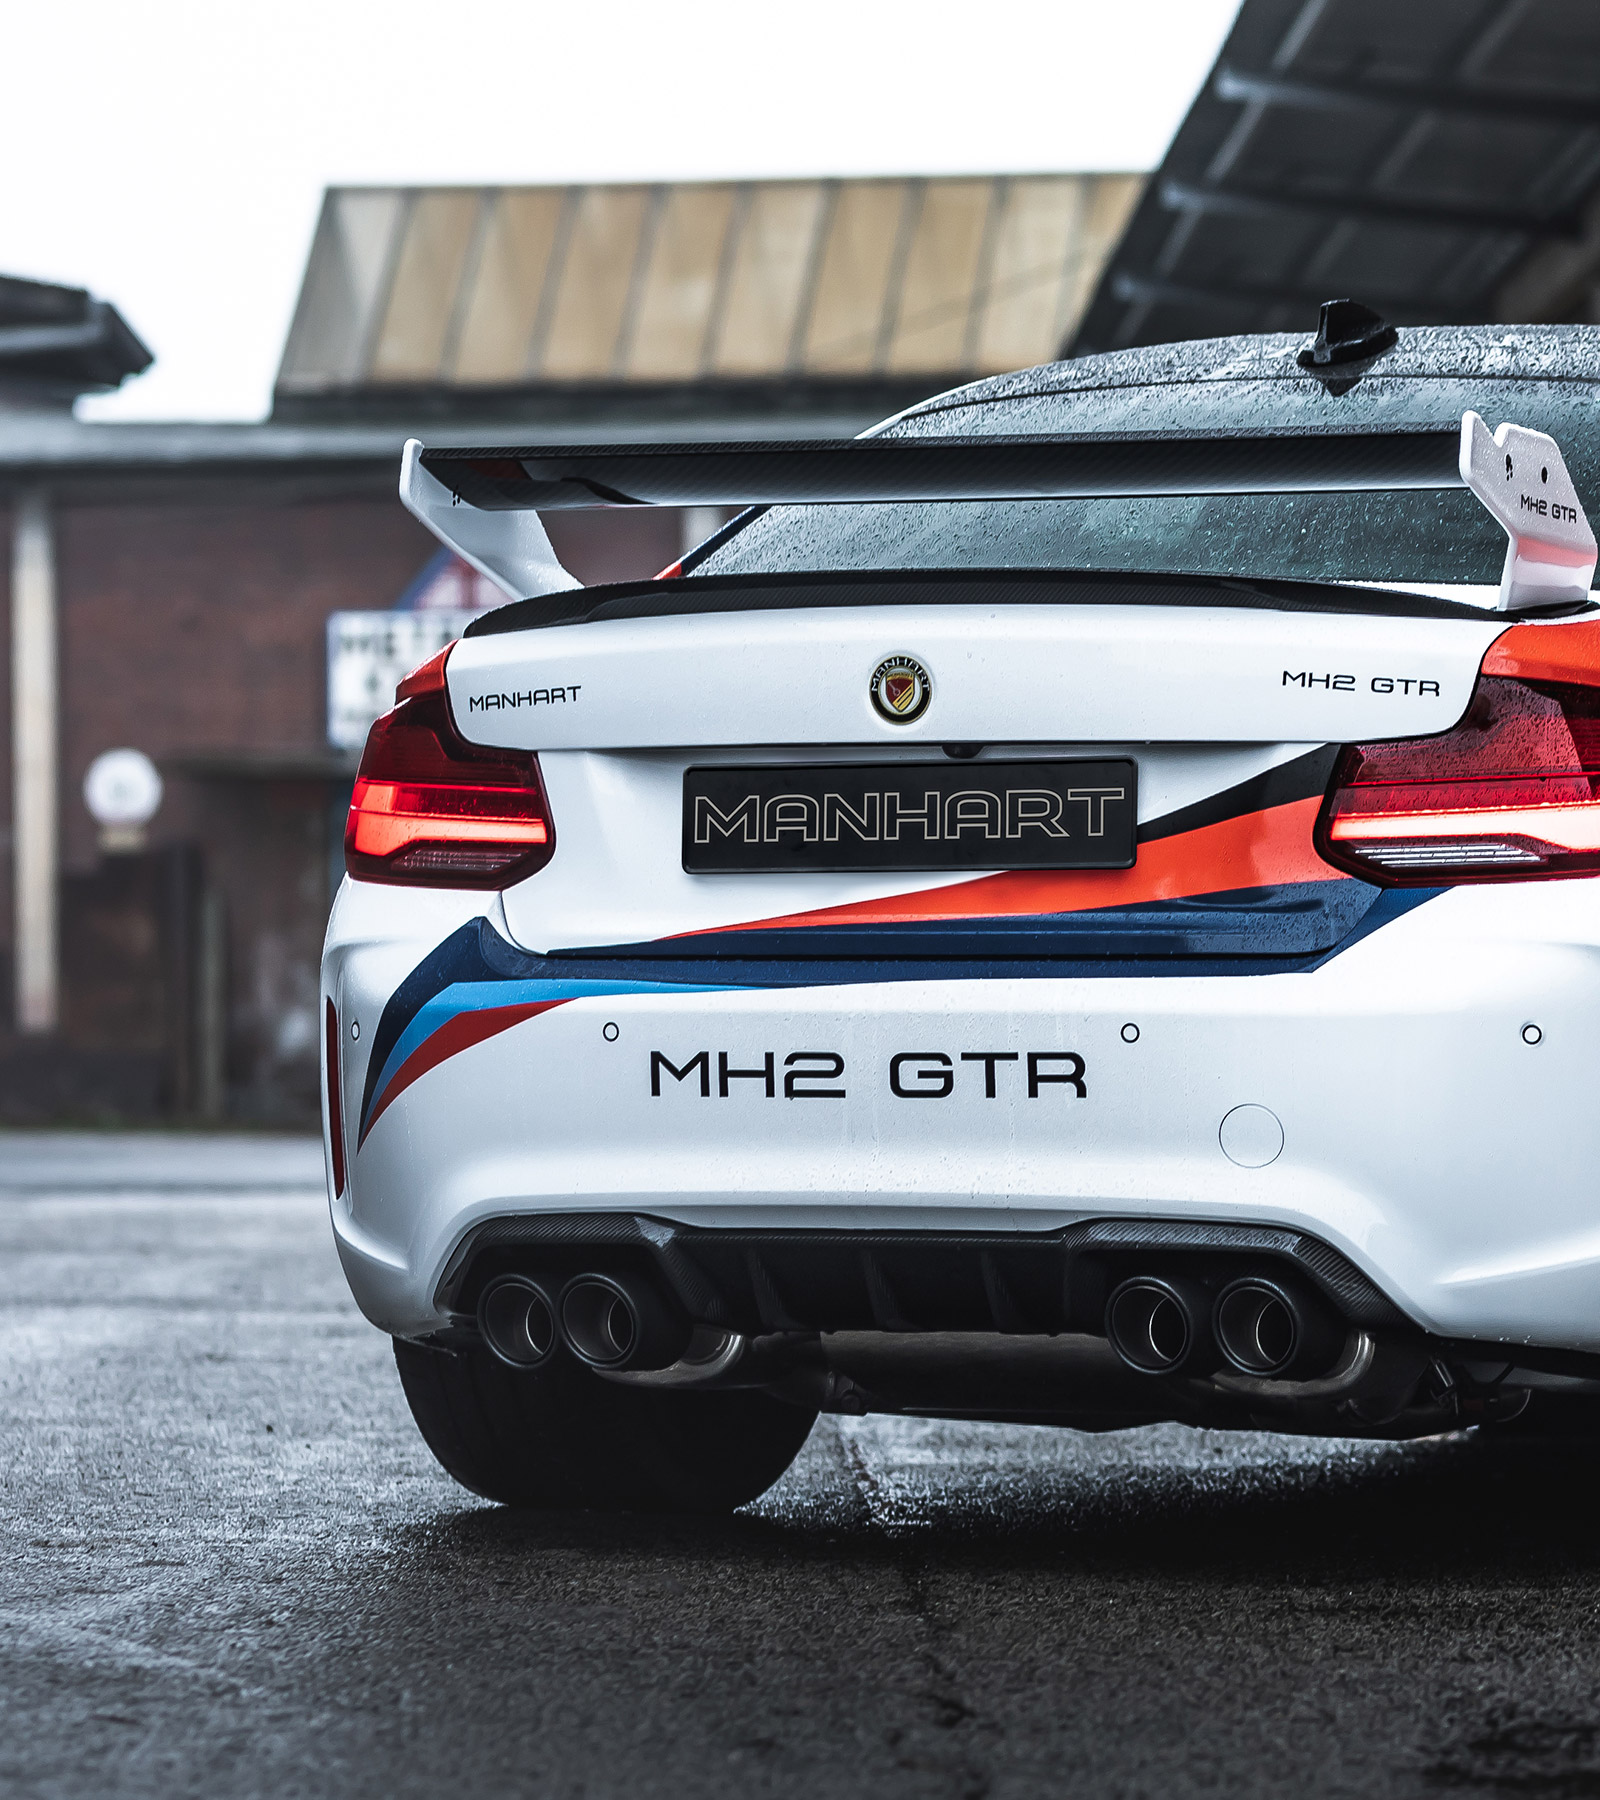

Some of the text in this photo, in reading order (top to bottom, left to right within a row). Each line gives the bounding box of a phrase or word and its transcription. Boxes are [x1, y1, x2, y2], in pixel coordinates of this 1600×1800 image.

[1521, 494, 1577, 524] MH2 GTR
[871, 656, 930, 692] MANHART
[1281, 670, 1440, 697] MH2 GTR
[469, 683, 582, 713] MANHART
[693, 788, 1125, 844] MANHART
[649, 1050, 1087, 1099] MH2 GTR
